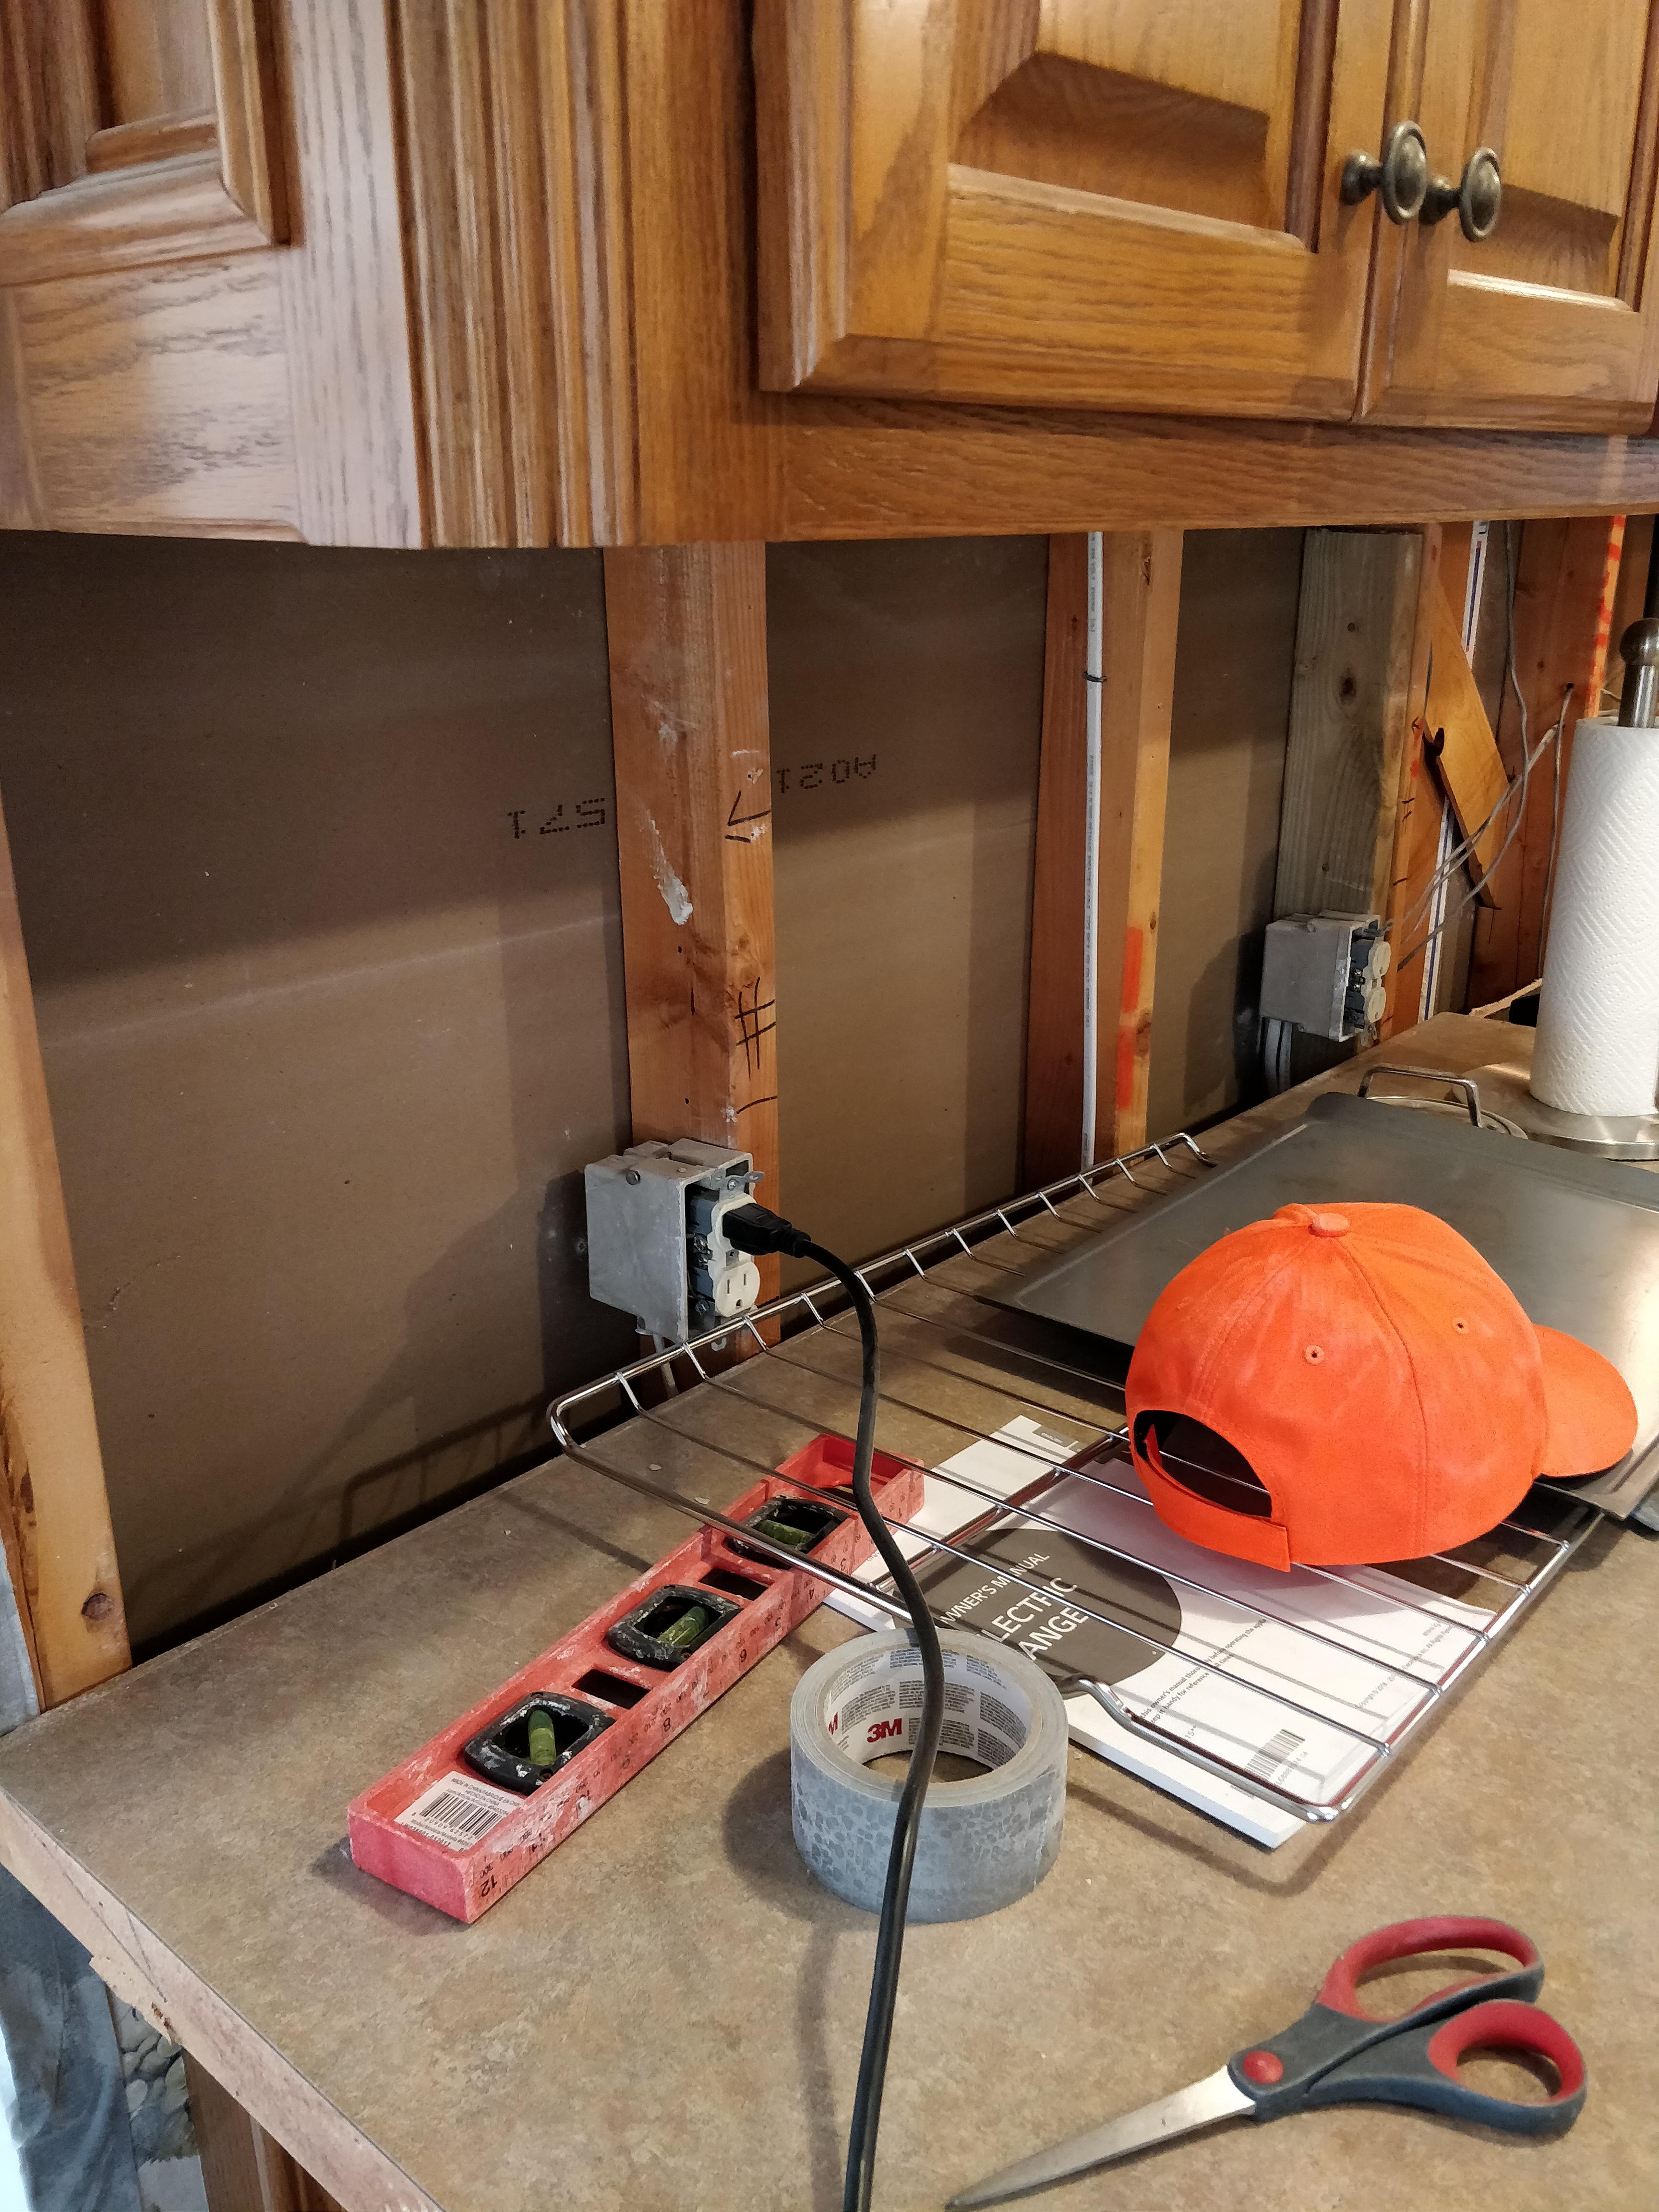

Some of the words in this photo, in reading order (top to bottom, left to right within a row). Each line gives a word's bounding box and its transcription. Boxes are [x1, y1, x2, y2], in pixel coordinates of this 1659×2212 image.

[506, 797, 606, 839] 571
[940, 1585, 997, 1623] WNER'S
[991, 1553, 1050, 1588] MNUAL
[977, 1577, 1077, 1642] LECTRIC
[1018, 1607, 1089, 1660] ANGE
[1151, 1691, 1170, 1708] owner's
[1169, 1676, 1188, 1692] manual
[1225, 1633, 1249, 1649] operating
[1150, 1714, 1161, 1724] eep
[1162, 1694, 1180, 1710] handy
[1177, 1688, 1187, 1697] for
[1186, 1671, 1210, 1691] reference
[663, 1716, 671, 1733] 8
[866, 1718, 902, 1743] 3M
[465, 1790, 481, 1798] HECHO
[425, 1817, 448, 1829] 20909
[481, 1875, 497, 1899] 12
